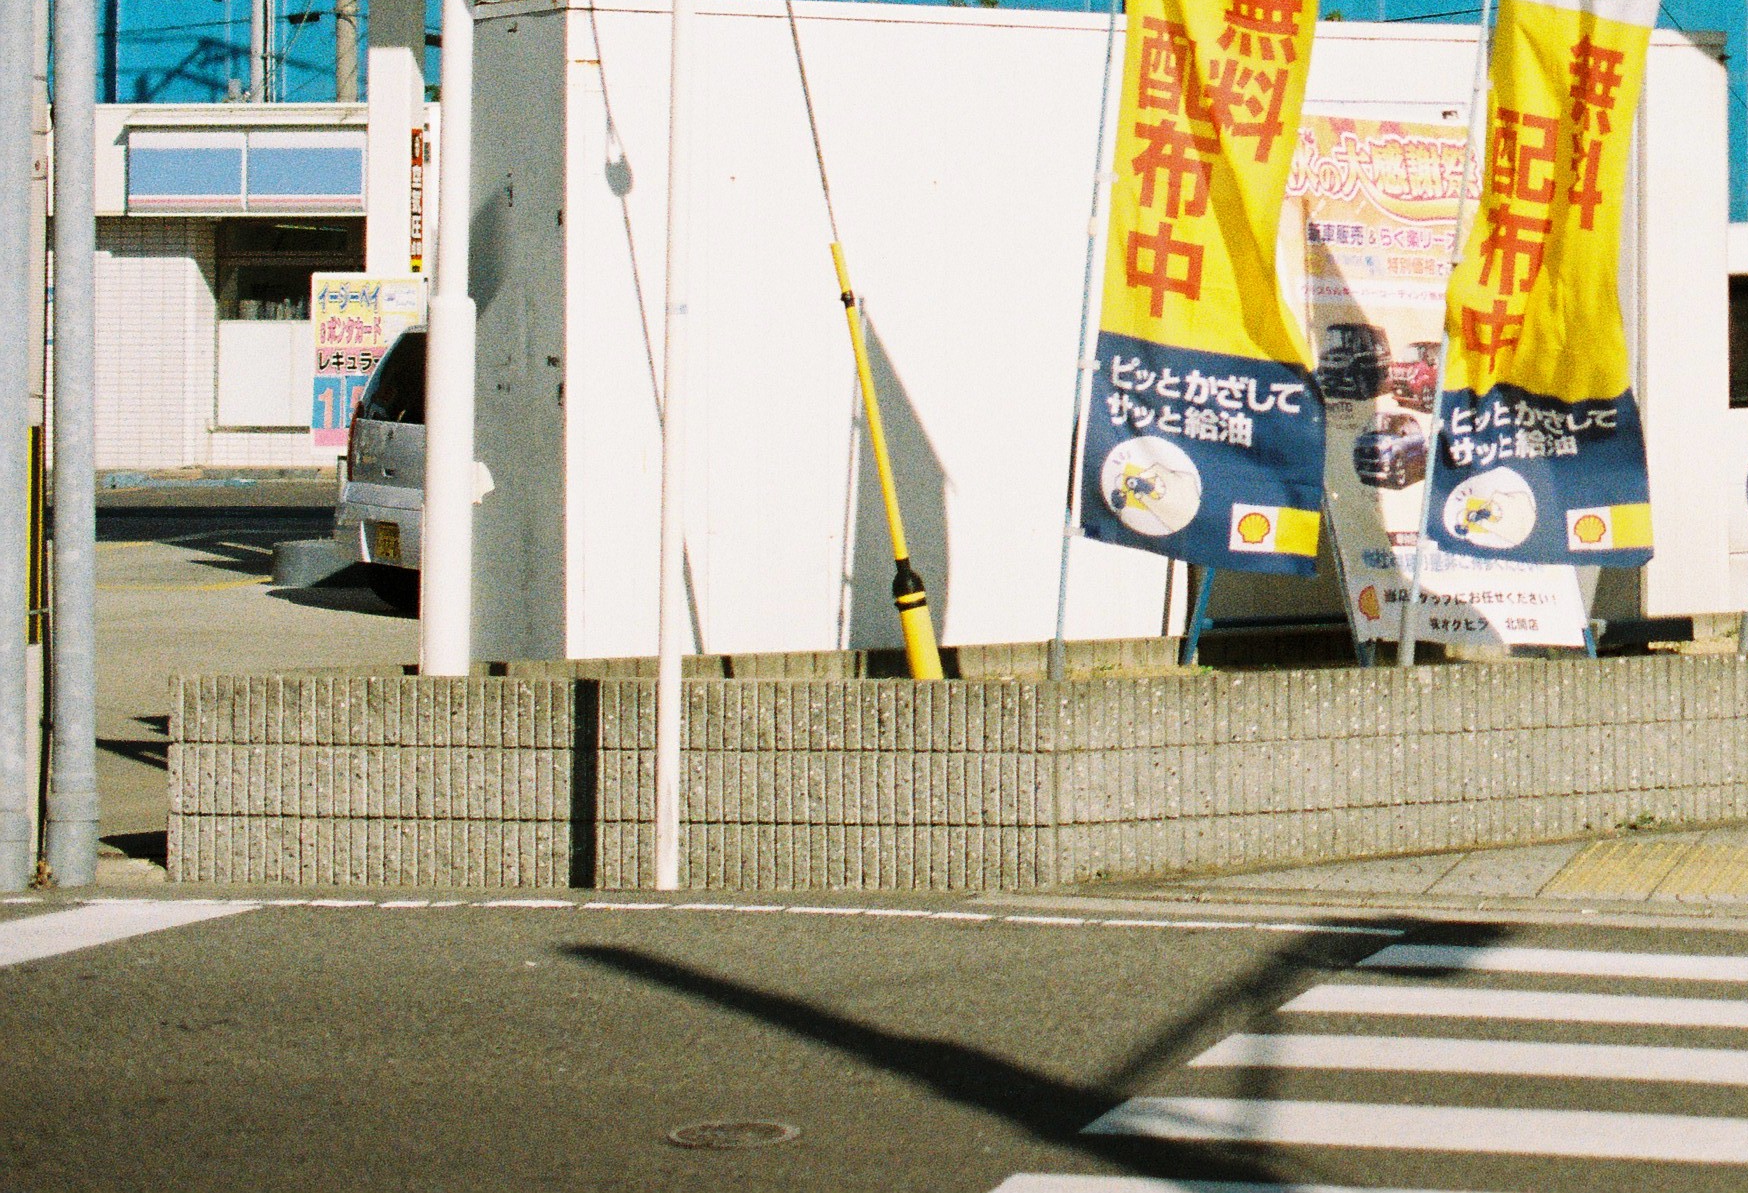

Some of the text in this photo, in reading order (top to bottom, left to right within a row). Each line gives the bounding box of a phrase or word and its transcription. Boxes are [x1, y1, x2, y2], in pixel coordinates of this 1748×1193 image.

[1124, 16, 1222, 319] 配布中
[1110, 355, 1305, 414] ピッとかざして
[1105, 392, 1254, 448] サッと給油
